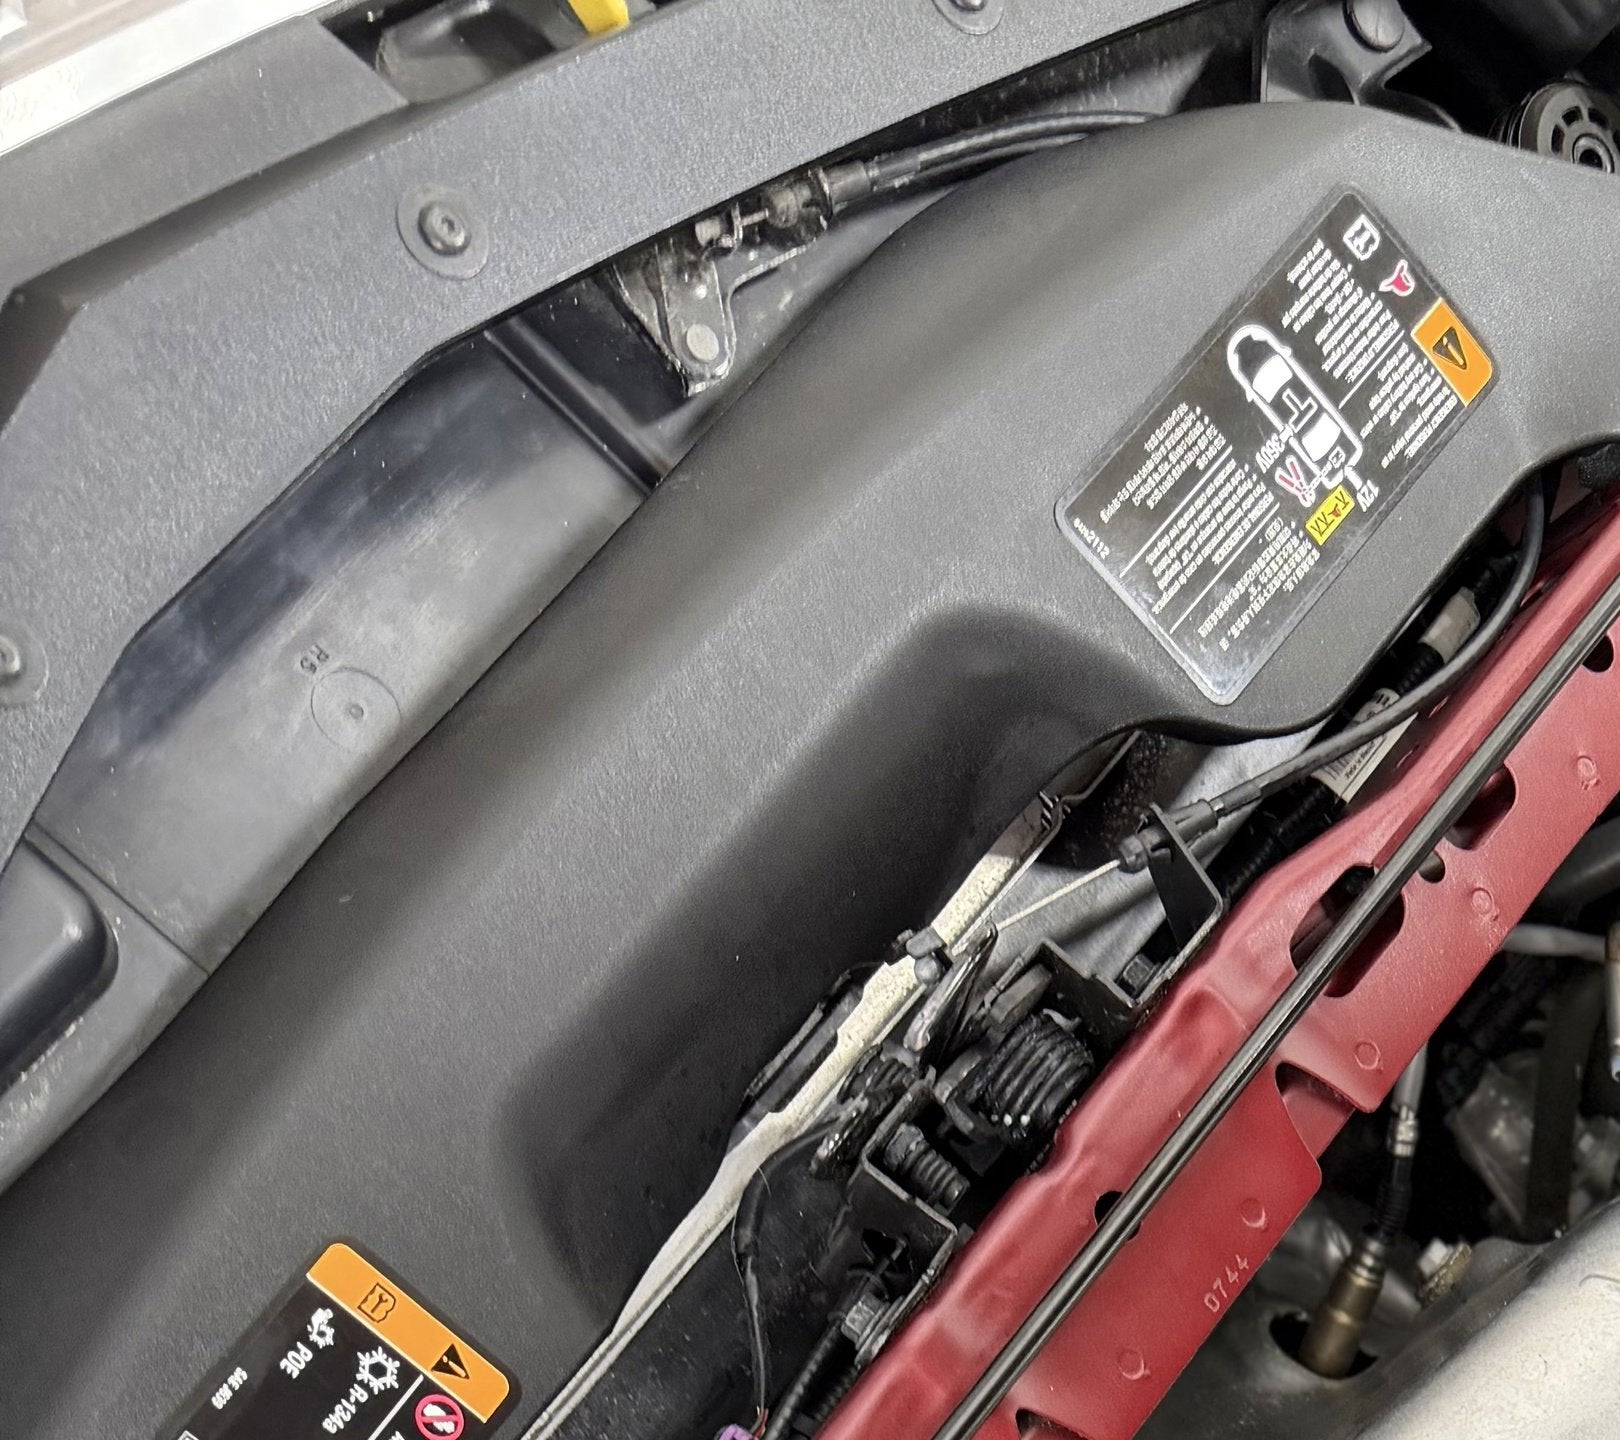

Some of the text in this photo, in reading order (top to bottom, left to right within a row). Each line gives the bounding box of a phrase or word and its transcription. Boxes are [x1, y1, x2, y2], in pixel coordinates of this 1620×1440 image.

[1255, 433, 1285, 473] 360V
[1351, 480, 1379, 512] 12V
[227, 1366, 248, 1391] SAE
[279, 1341, 313, 1379] POE
[322, 1384, 368, 1434] R-134a
